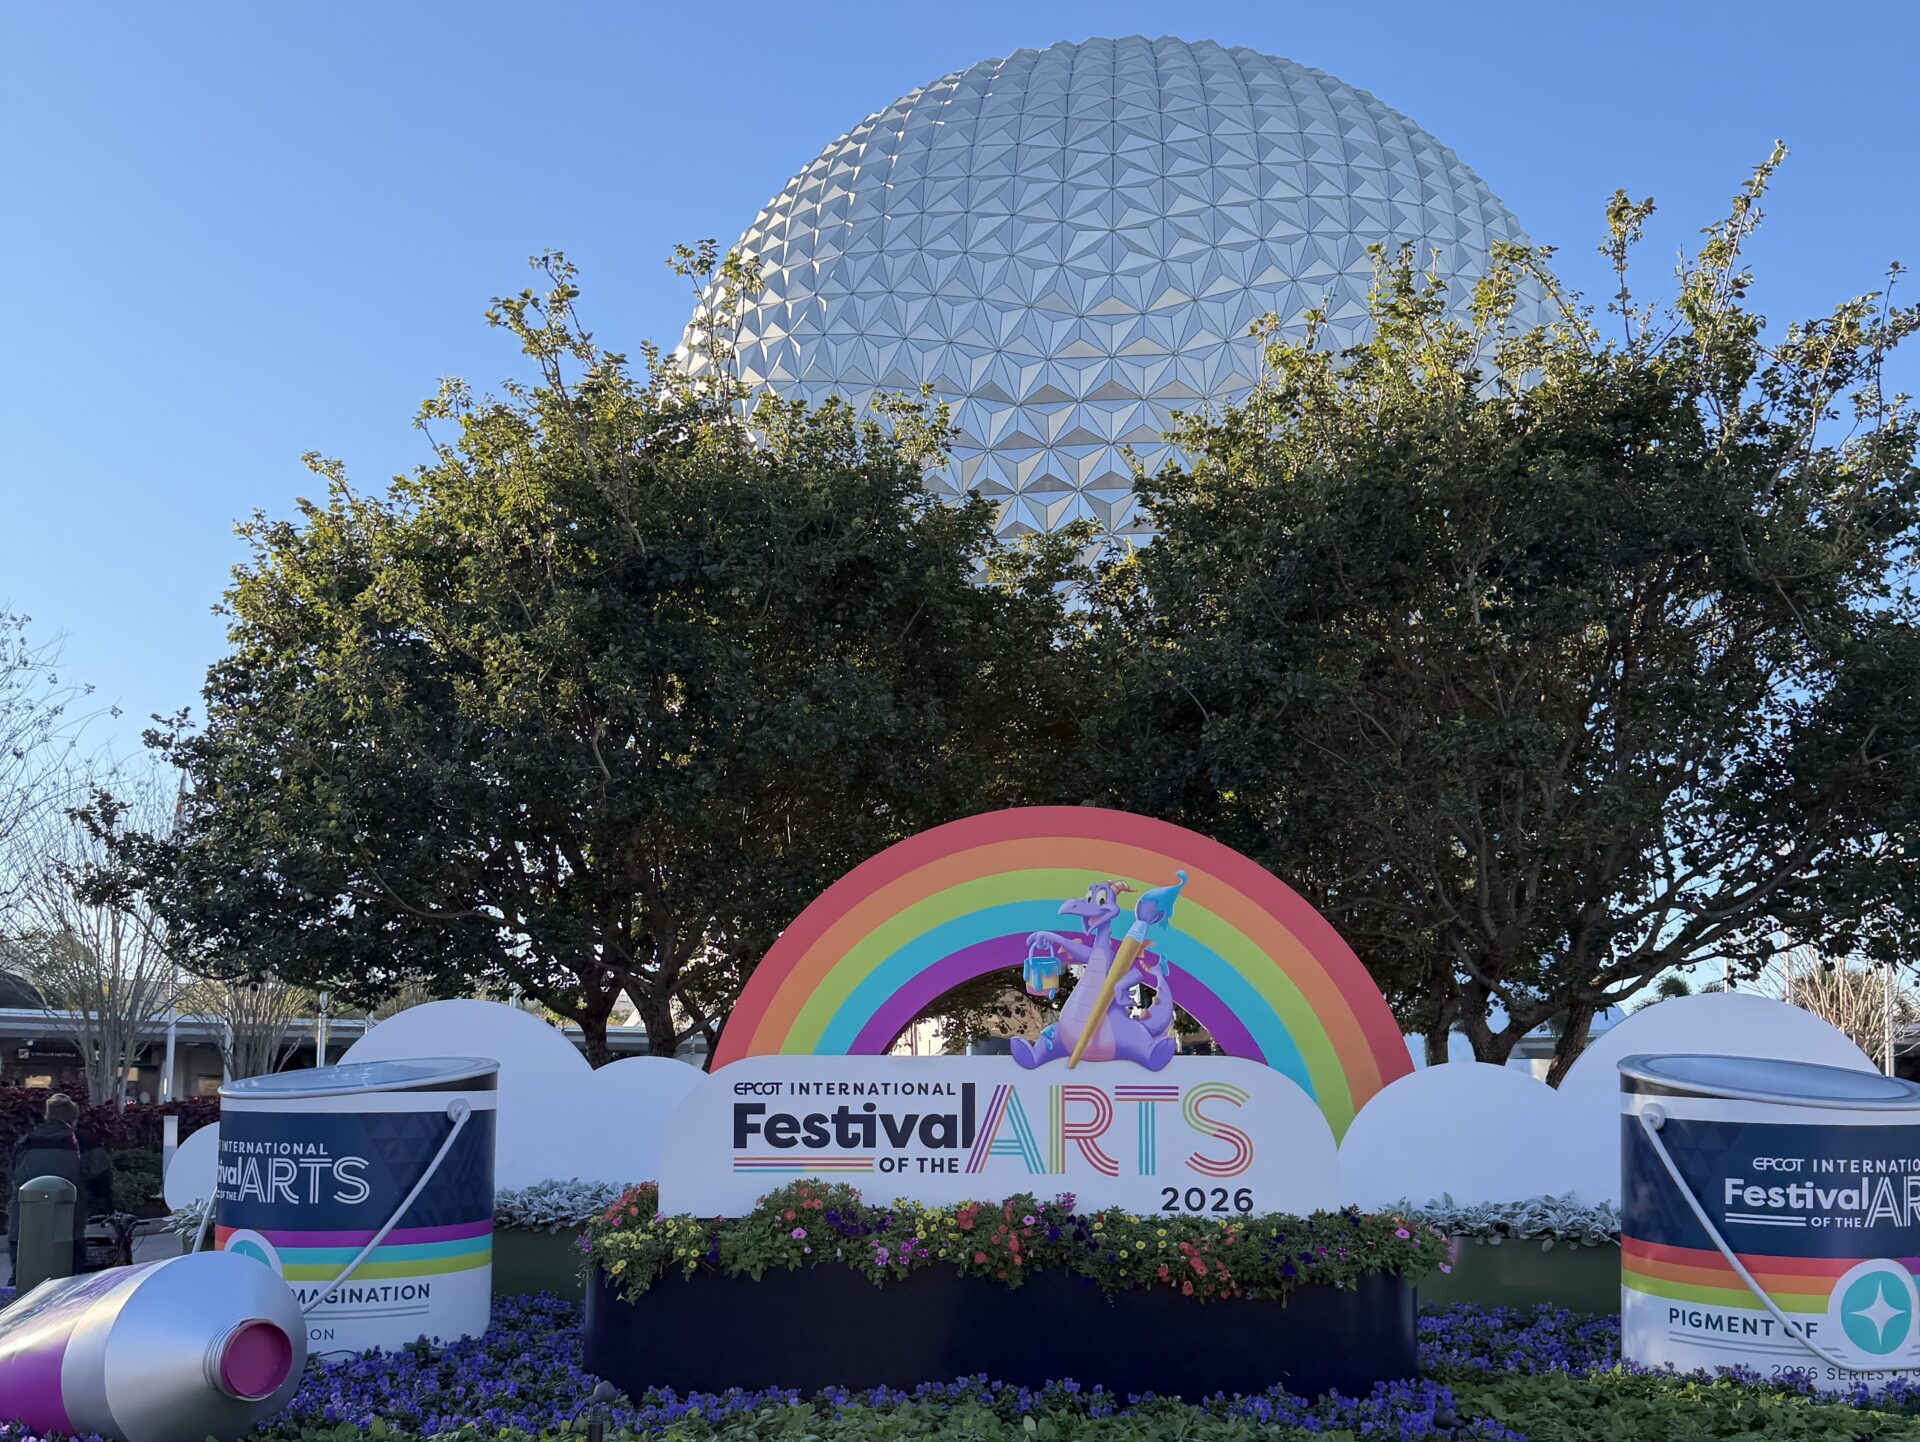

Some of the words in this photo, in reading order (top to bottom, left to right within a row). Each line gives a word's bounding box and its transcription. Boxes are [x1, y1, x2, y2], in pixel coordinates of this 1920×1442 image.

[734, 1082, 782, 1095] EPCOT
[790, 1082, 956, 1096] INTERNATIONAL
[733, 1082, 976, 1149] Festival
[965, 1081, 1254, 1178] ARTS
[878, 1157, 909, 1173] OF
[916, 1157, 959, 1173] THE
[1753, 1157, 1805, 1171] EPCOT
[238, 1156, 370, 1204] ARTS
[226, 1191, 237, 1200] THE
[1161, 1187, 1254, 1212] 2026
[1724, 1177, 1869, 1210] Festival
[1811, 1216, 1831, 1228] OF
[1835, 1217, 1861, 1228] THE
[291, 1283, 430, 1304] MAGINATION
[1669, 1307, 1774, 1336] PIGMENT
[1784, 1321, 1818, 1339] OF
[1827, 1367, 1884, 1380] SERIES
